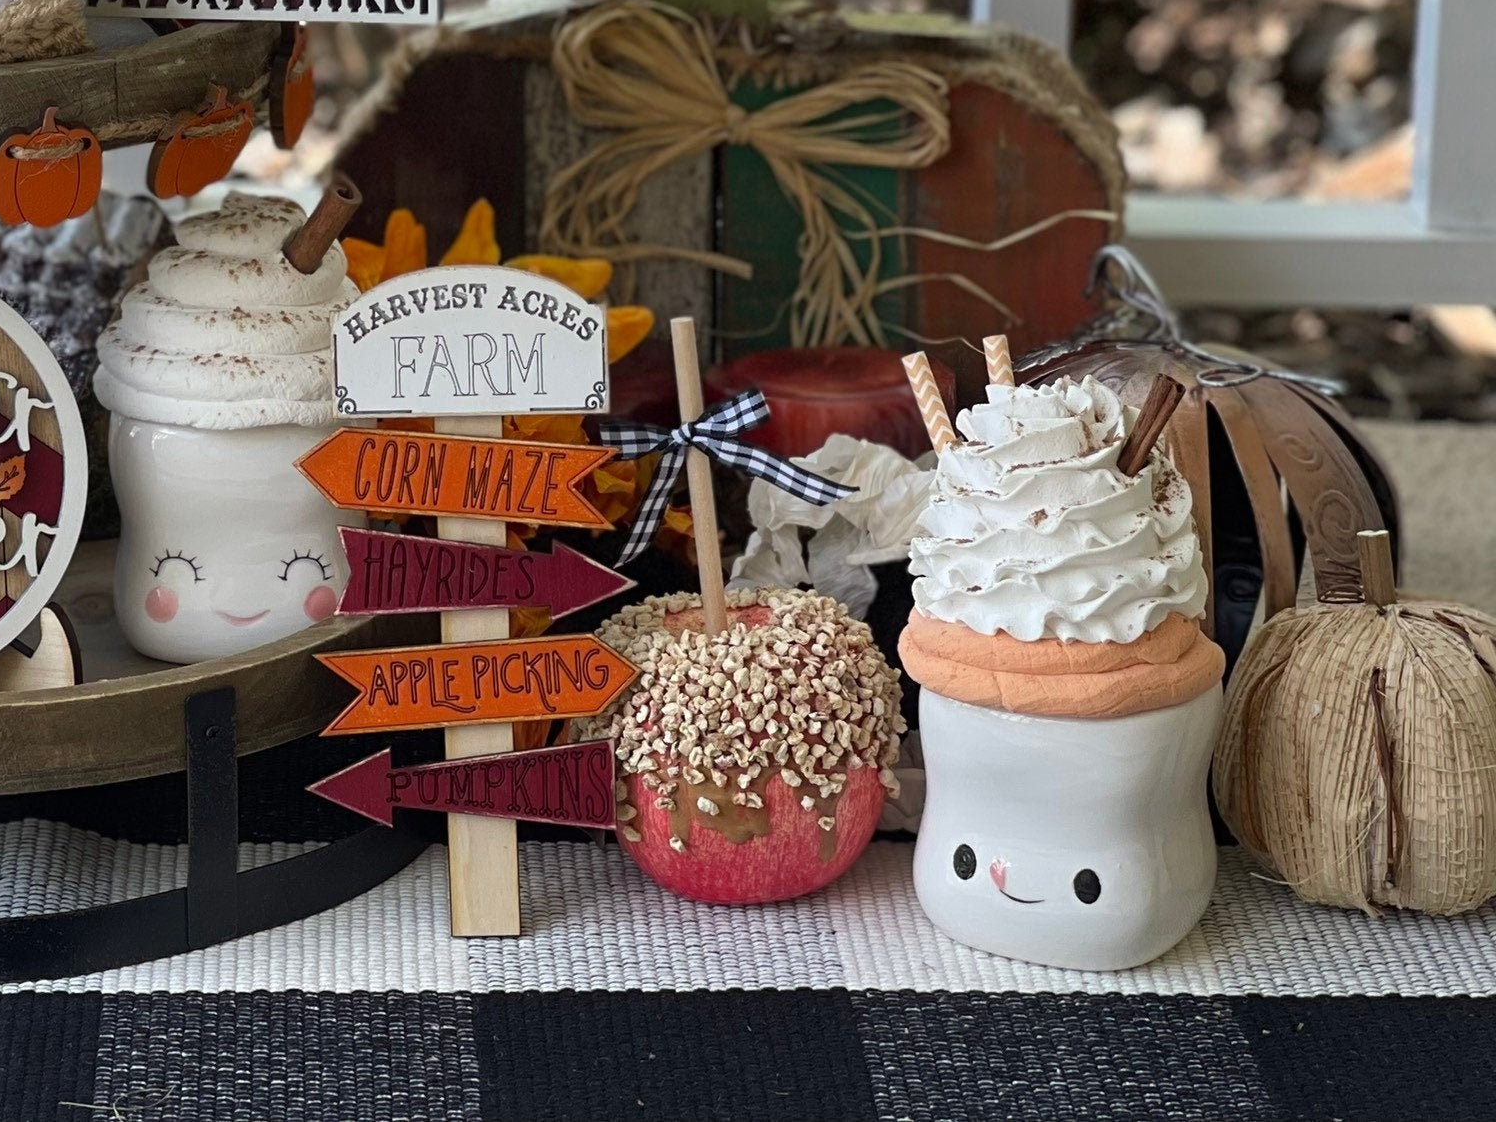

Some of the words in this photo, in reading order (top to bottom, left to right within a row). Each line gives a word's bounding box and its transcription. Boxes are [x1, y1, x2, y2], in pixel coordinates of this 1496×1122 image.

[343, 283, 488, 344] HARVEST
[497, 286, 599, 342] ACRES
[390, 332, 547, 399] FARM
[354, 437, 448, 507] CORN
[463, 445, 567, 516] MAZE
[363, 539, 536, 608] HAYRIDES
[368, 660, 477, 713] APPLE
[473, 648, 609, 713] PICKING
[386, 747, 611, 825] PUMPKINS
